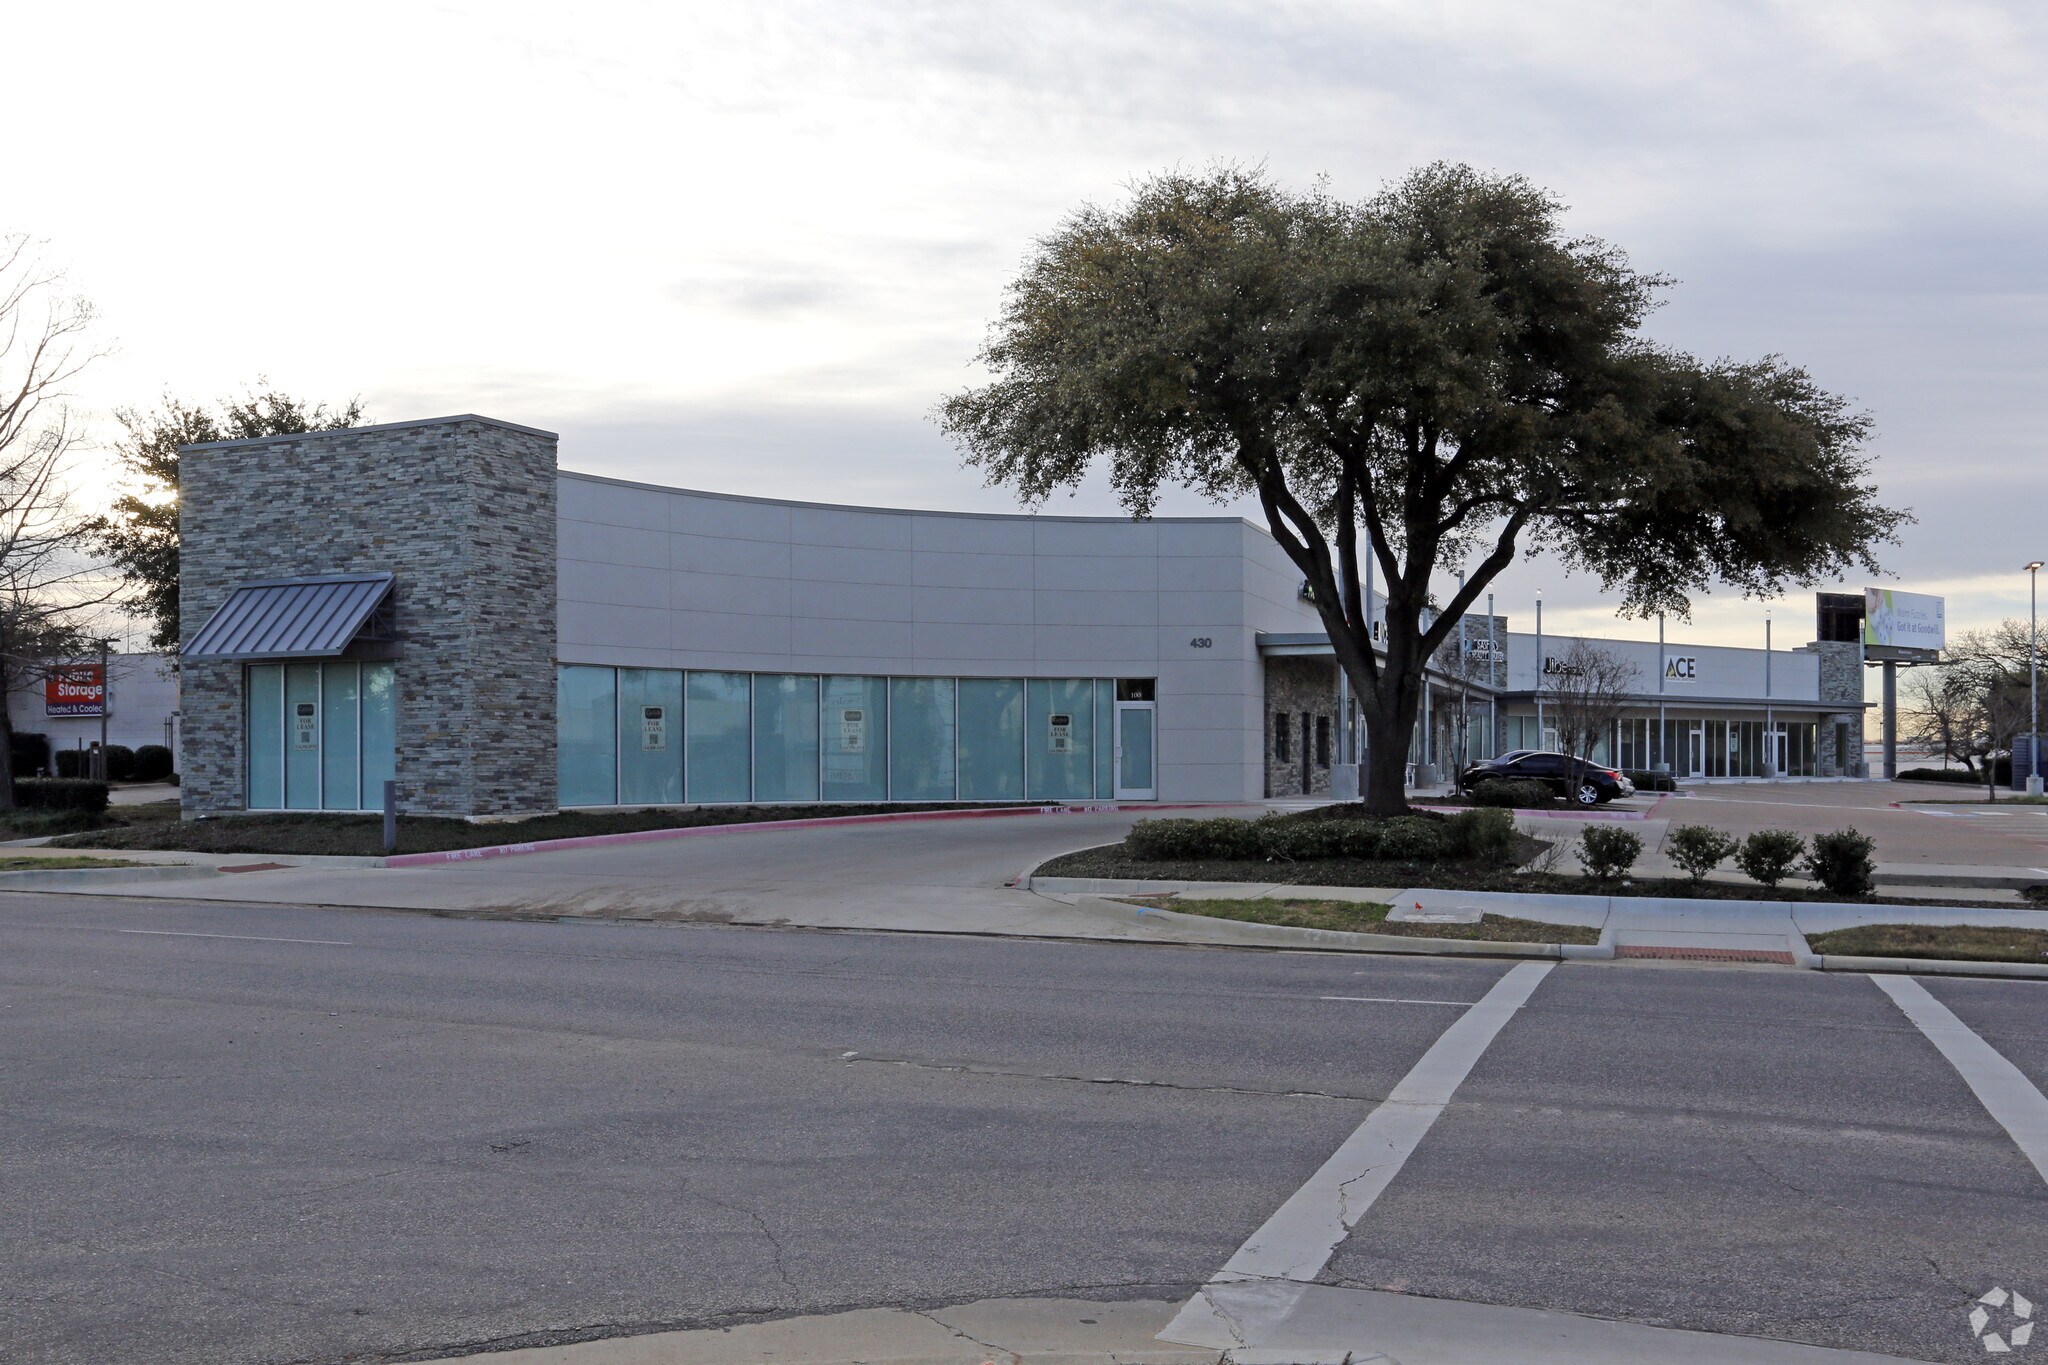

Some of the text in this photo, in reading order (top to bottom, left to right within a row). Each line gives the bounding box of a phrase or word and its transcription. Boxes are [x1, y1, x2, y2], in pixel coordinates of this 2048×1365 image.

[1896, 620, 1906, 632] Got
[1911, 623, 1917, 633] at
[1190, 637, 1212, 649] 430
[1666, 658, 1696, 678] ACE
[58, 683, 102, 700] Storage
[1130, 691, 1142, 699] 100
[47, 705, 72, 714] Heated
[72, 705, 78, 713] &
[446, 852, 461, 860] FIRE
[464, 850, 482, 858] LANE
